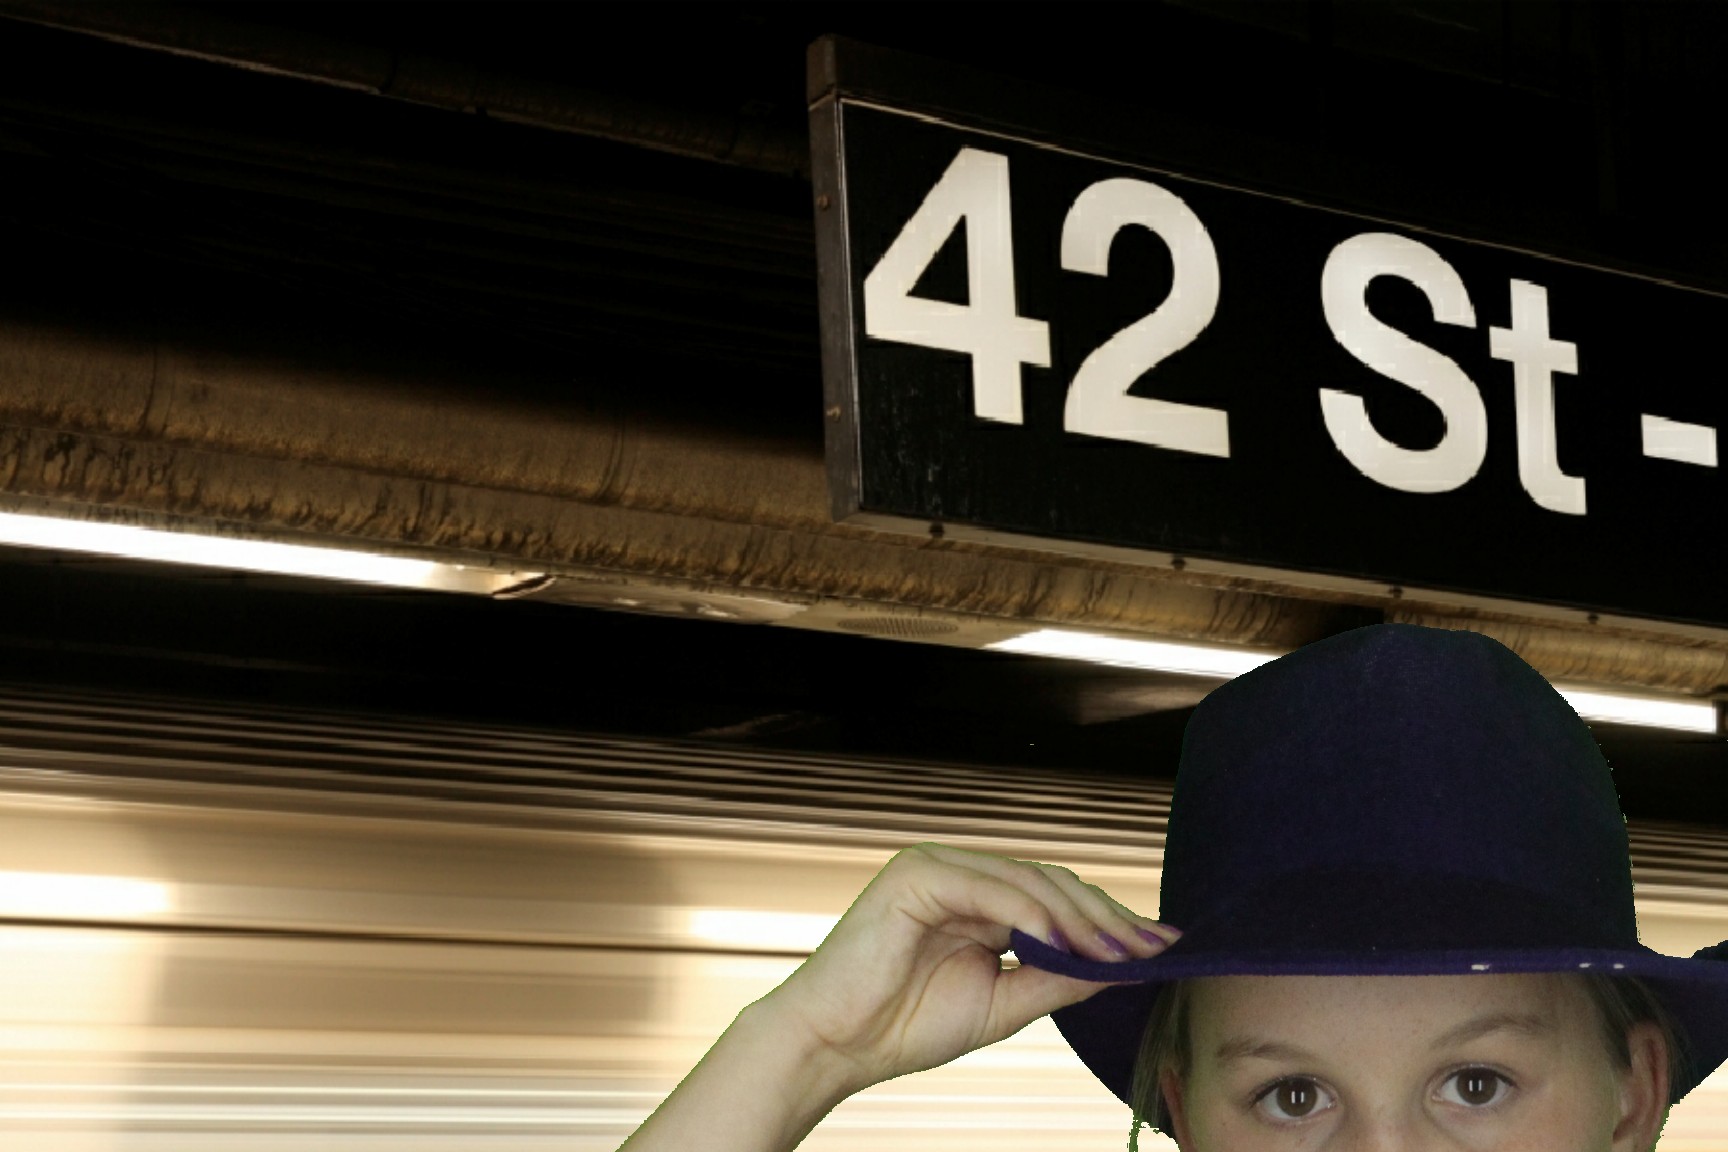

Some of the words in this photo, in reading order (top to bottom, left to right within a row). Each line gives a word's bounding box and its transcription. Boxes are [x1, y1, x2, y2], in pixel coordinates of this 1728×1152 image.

[863, 146, 1231, 459] 42
[1319, 232, 1588, 516] St
[1641, 414, 1719, 468] -
